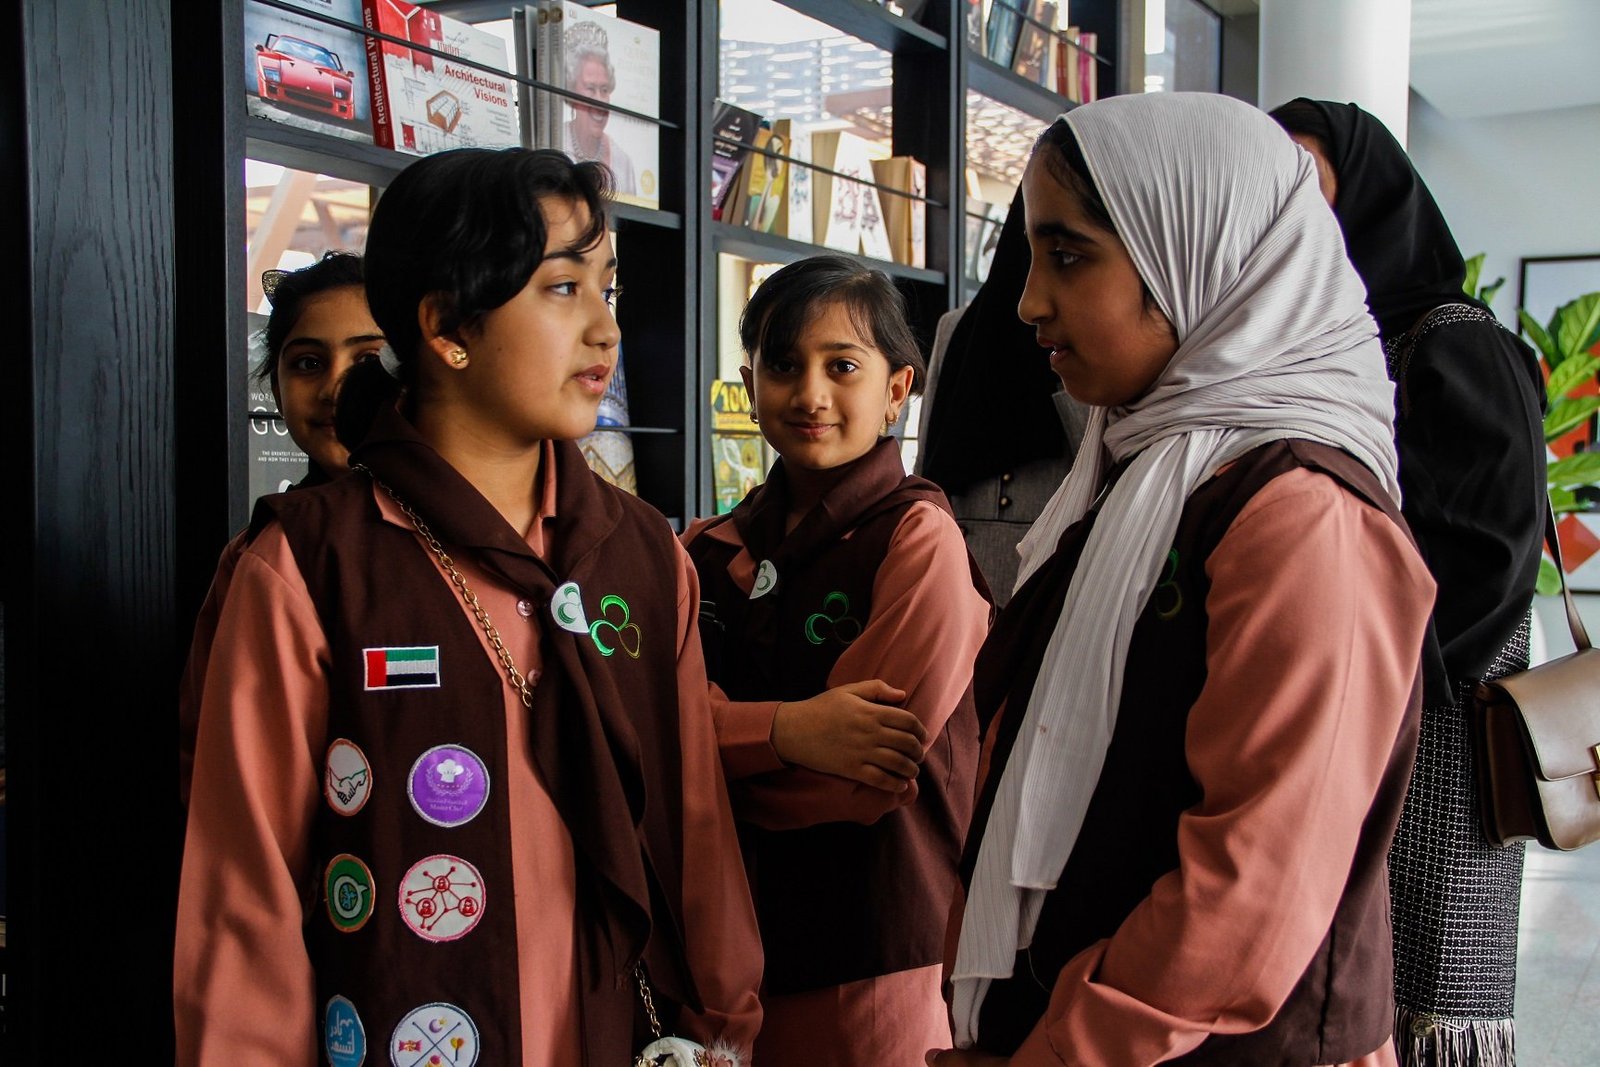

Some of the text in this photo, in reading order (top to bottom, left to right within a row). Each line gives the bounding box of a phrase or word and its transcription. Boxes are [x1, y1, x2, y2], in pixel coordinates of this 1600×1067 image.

[364, 7, 375, 49] Vions
[368, 51, 385, 125] Architectural
[444, 65, 507, 93] Architectural
[474, 87, 508, 108] Visions
[251, 392, 275, 402] WORL
